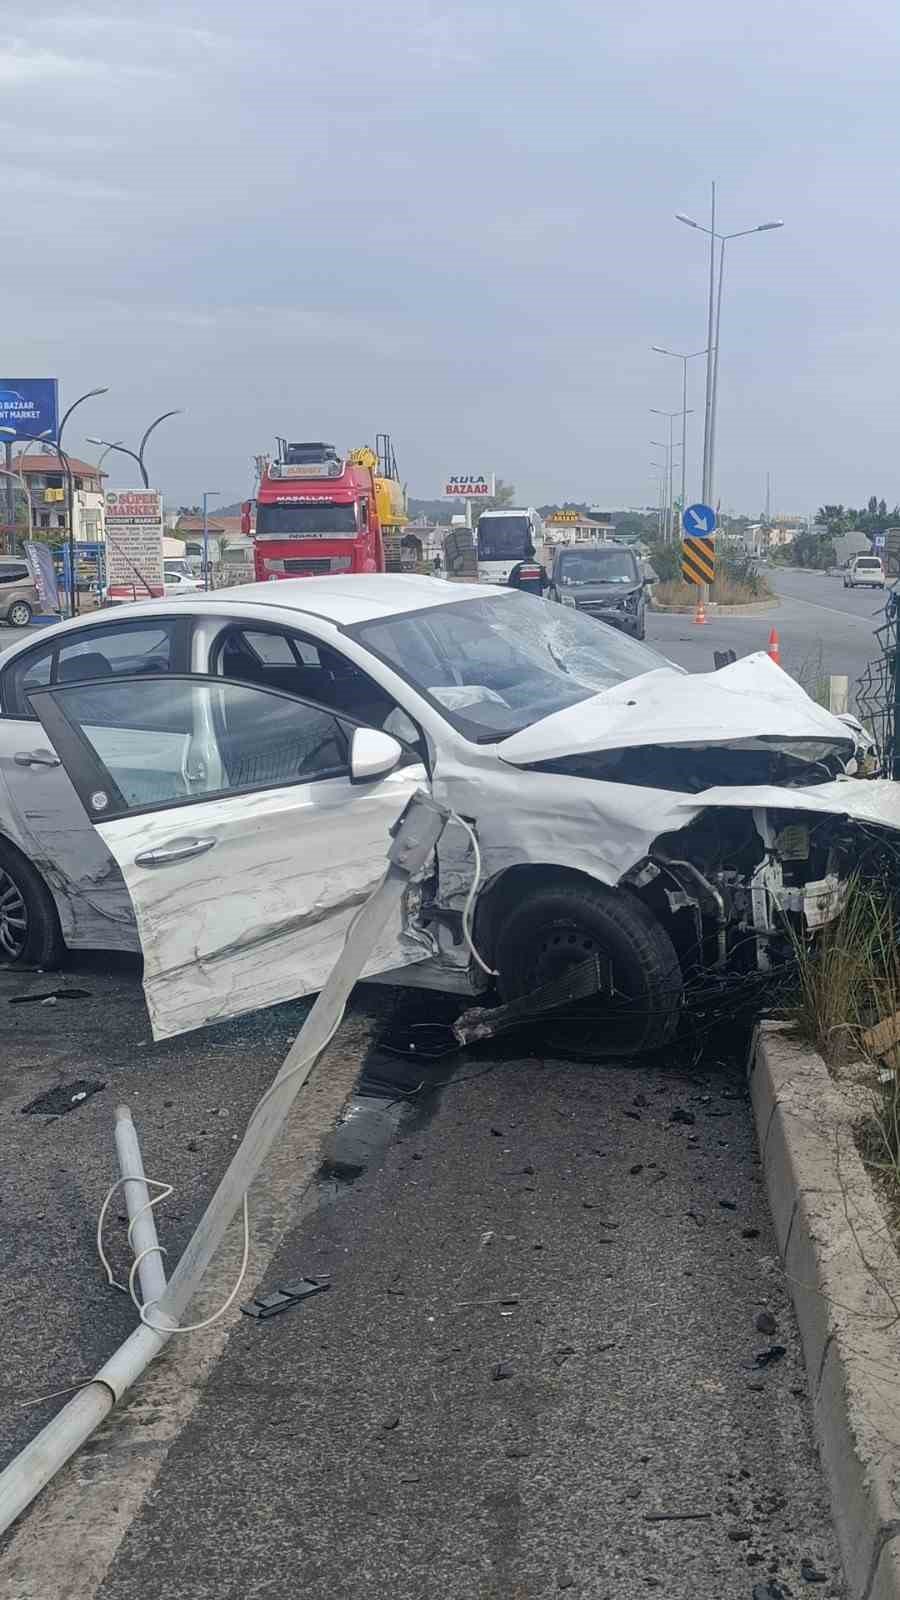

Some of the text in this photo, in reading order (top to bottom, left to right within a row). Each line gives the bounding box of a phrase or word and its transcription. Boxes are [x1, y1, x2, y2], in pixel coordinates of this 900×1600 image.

[4, 401, 34, 409] BAZAAR
[450, 476, 485, 484] KULA
[446, 485, 488, 494] BAZAAR
[106, 504, 160, 515] MARKET
